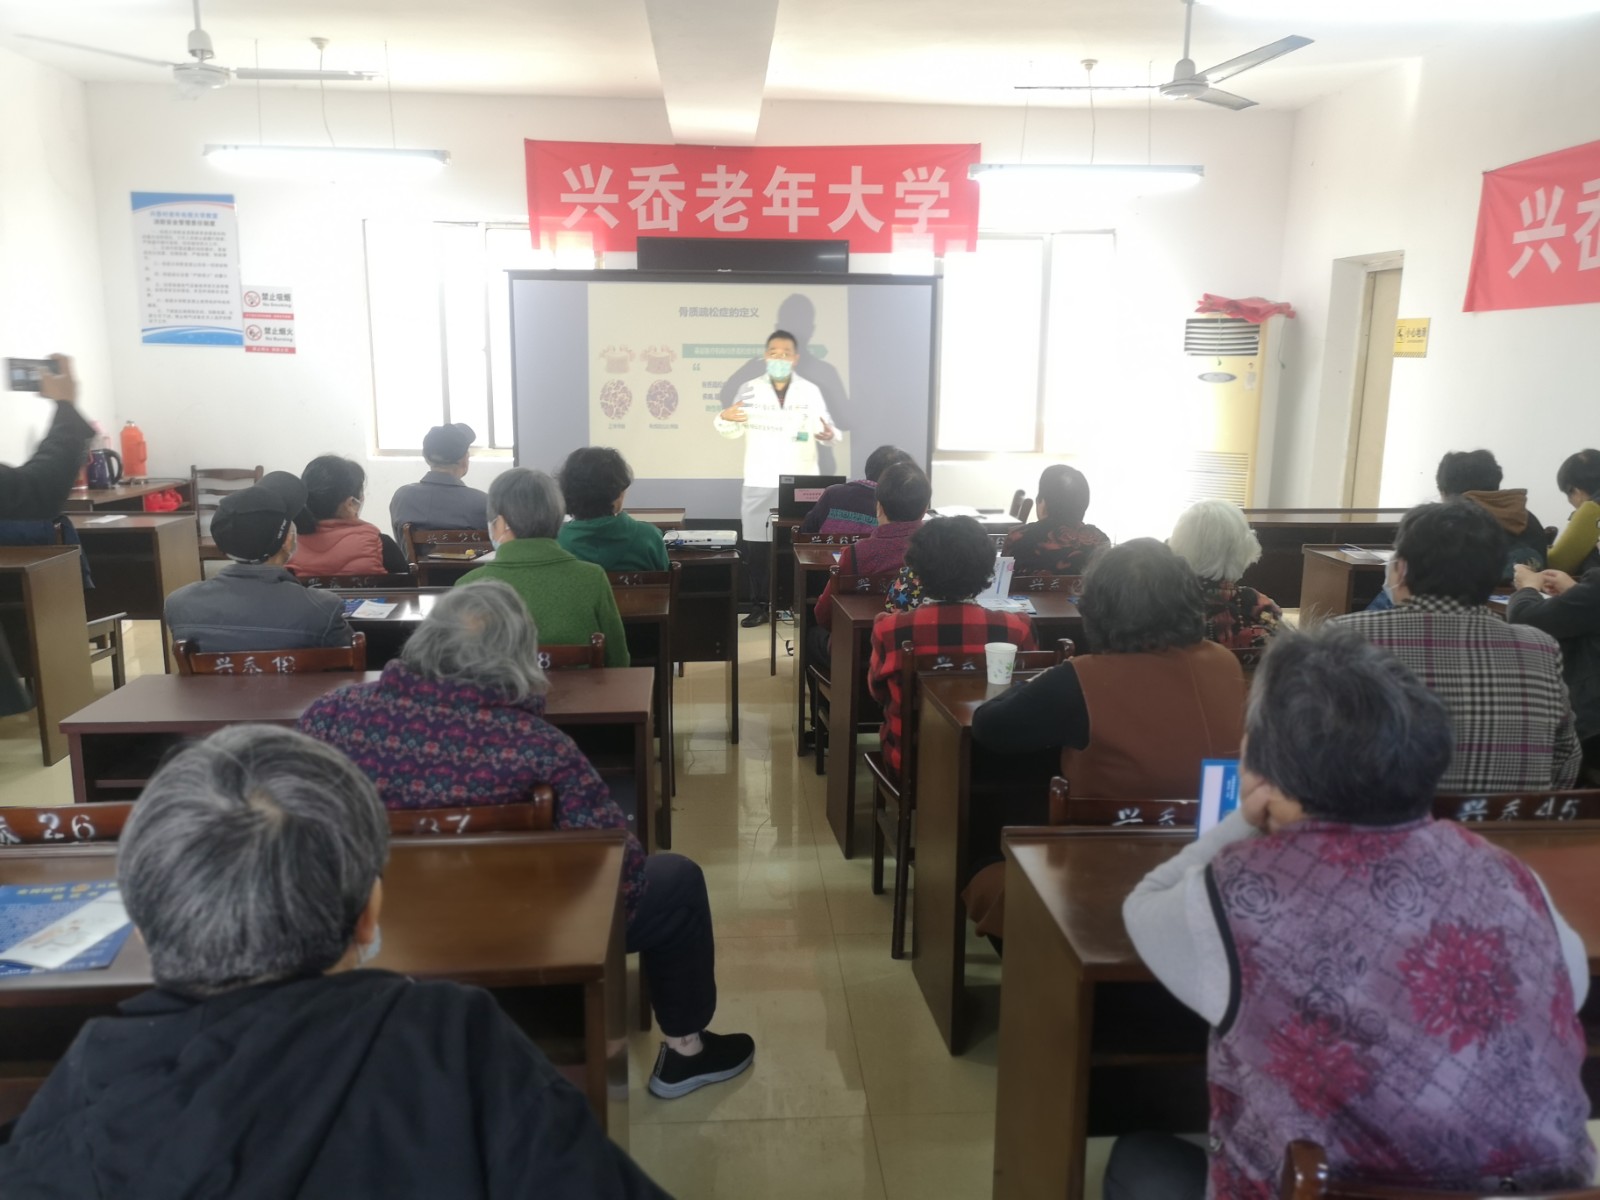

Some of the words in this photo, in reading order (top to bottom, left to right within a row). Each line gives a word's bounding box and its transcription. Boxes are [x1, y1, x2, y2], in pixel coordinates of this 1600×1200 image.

[560, 163, 950, 234] 兴岙老年大学
[679, 306, 760, 318] 骨质疏松症的定义
[37, 812, 97, 840] 26
